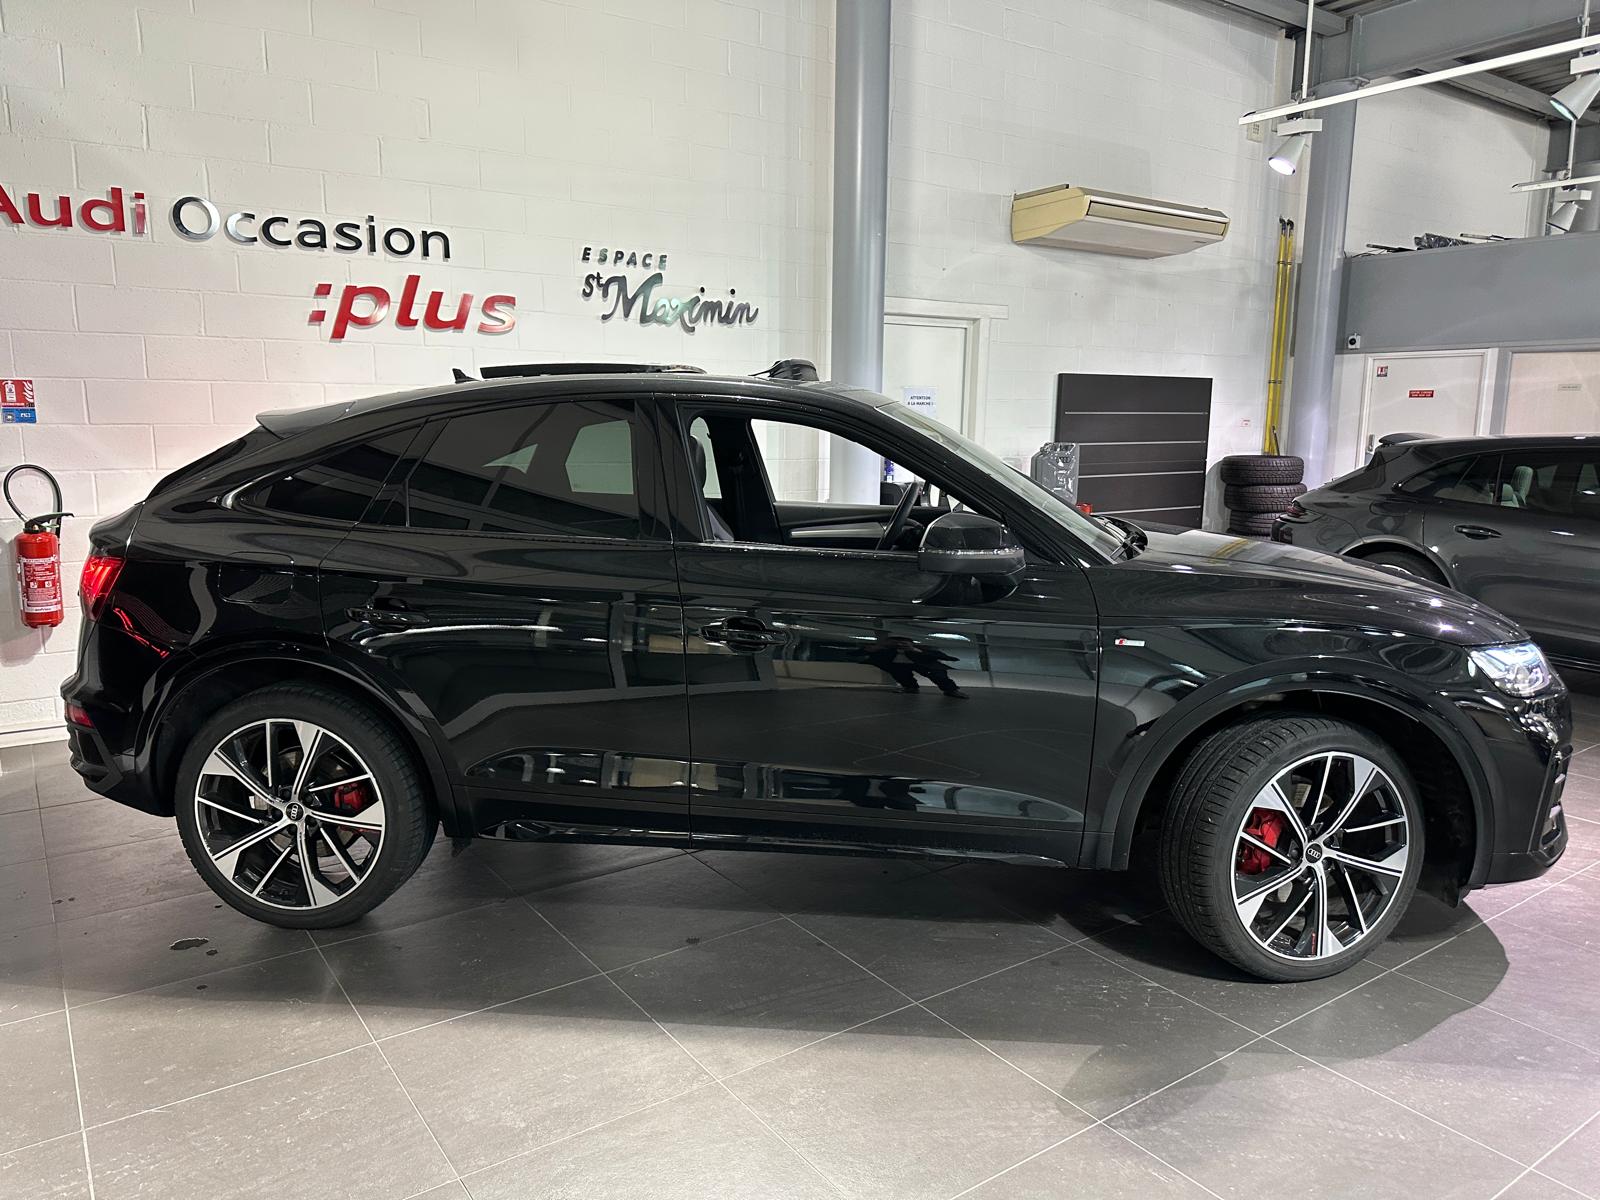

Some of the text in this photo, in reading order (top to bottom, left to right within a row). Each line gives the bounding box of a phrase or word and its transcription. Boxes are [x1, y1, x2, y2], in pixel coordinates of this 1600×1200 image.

[172, 196, 451, 259] Occasion
[581, 246, 668, 271] ESPACE
[601, 272, 759, 333] Maximin
